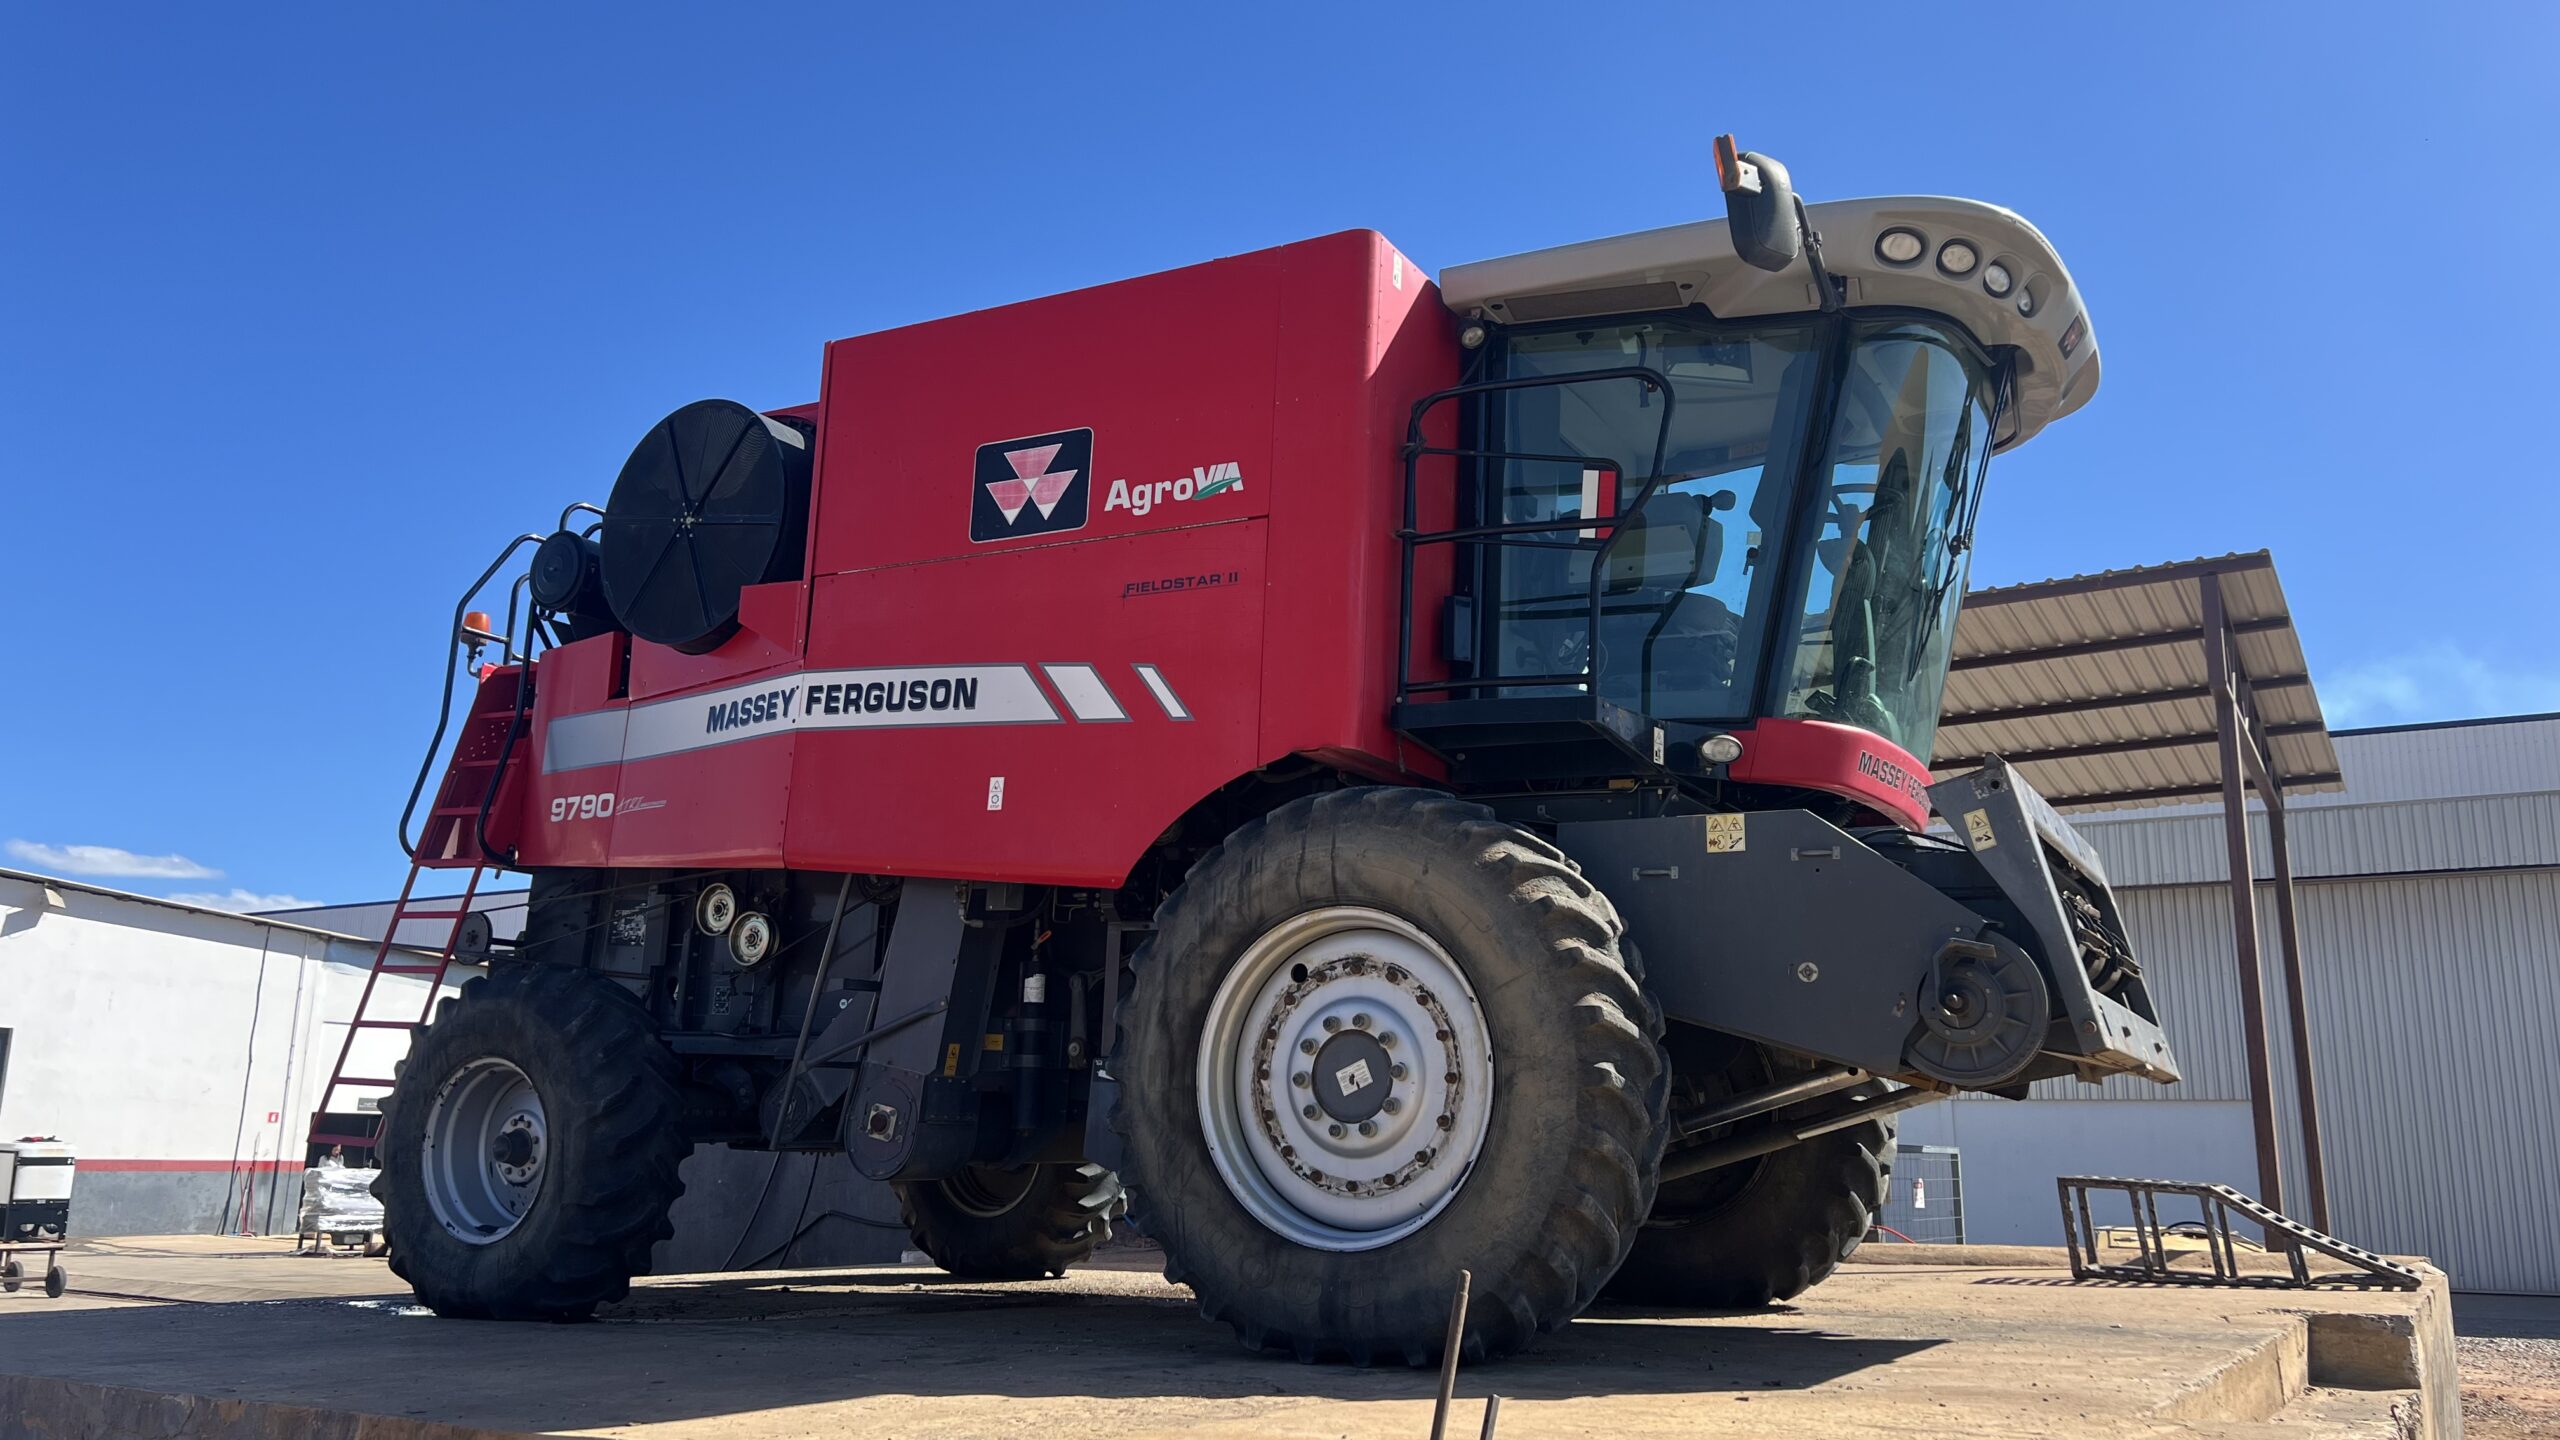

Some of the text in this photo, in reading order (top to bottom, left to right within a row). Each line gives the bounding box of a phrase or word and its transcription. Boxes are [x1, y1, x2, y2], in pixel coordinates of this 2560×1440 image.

[1125, 573, 1222, 595] FIELDSTAR
[706, 677, 979, 734] MASSEY FERGUSON
[1858, 750, 1908, 792] MASSEY
[550, 792, 616, 823] 9790
